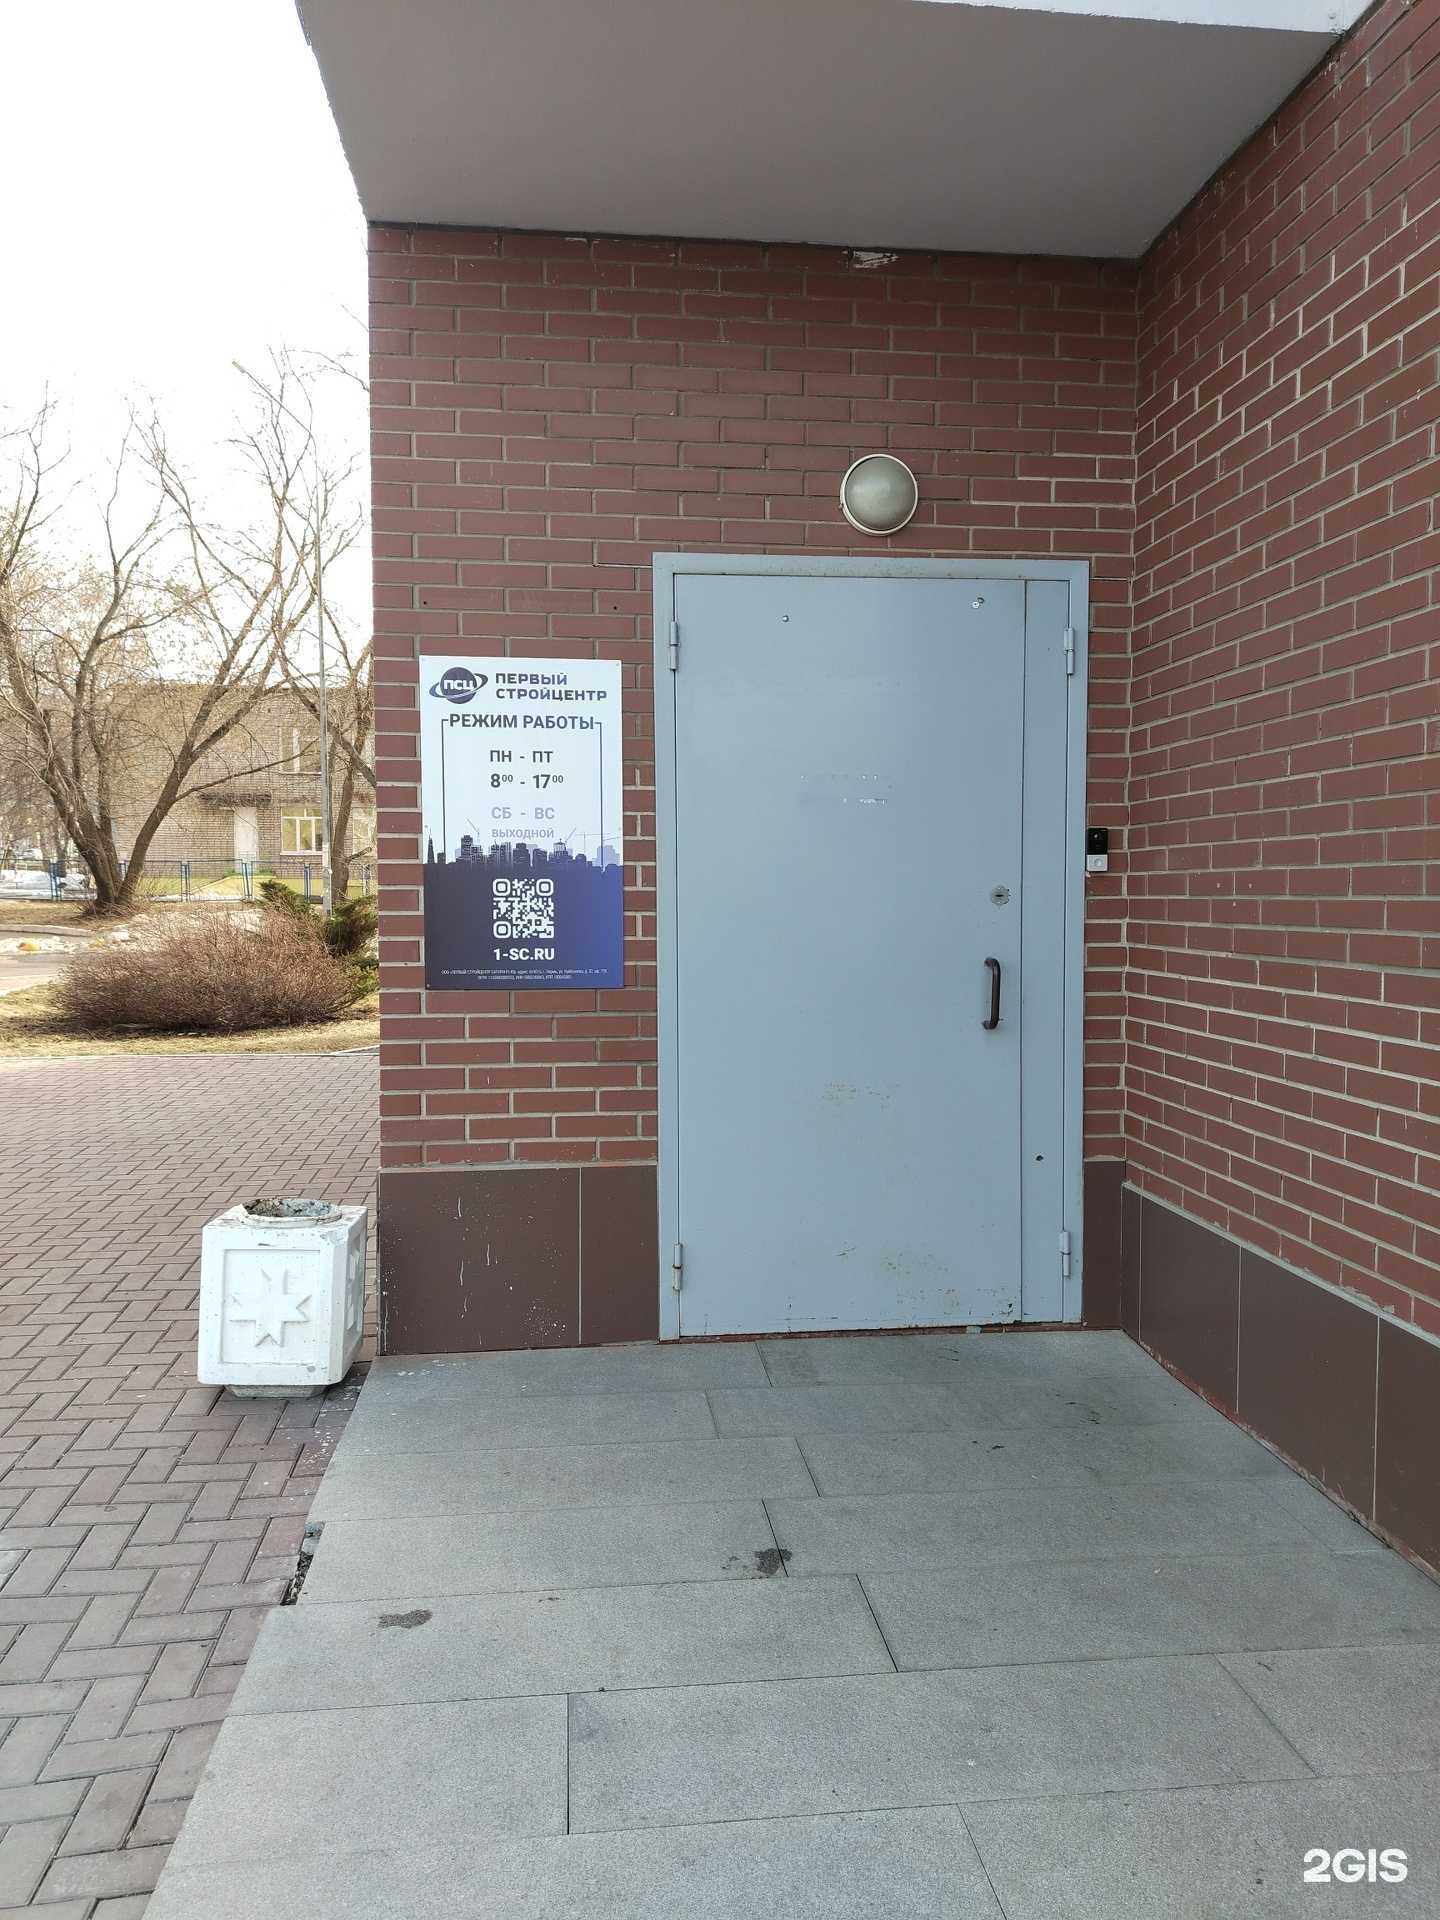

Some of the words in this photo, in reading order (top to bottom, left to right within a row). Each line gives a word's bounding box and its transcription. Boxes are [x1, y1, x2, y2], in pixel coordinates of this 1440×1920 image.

[443, 679, 474, 691] ПСЦ
[495, 672, 568, 685] ПЕРВЫЙ
[495, 687, 608, 702] СТРОЙЦЕНТР
[449, 713, 518, 728] РЕЖИМ
[523, 715, 594, 730] РАБОТЫ
[489, 750, 512, 763] ПН
[532, 750, 553, 764] ПТ
[491, 807, 512, 820] СБ
[534, 807, 555, 820] ВС
[493, 947, 555, 961] 1-SC.RU
